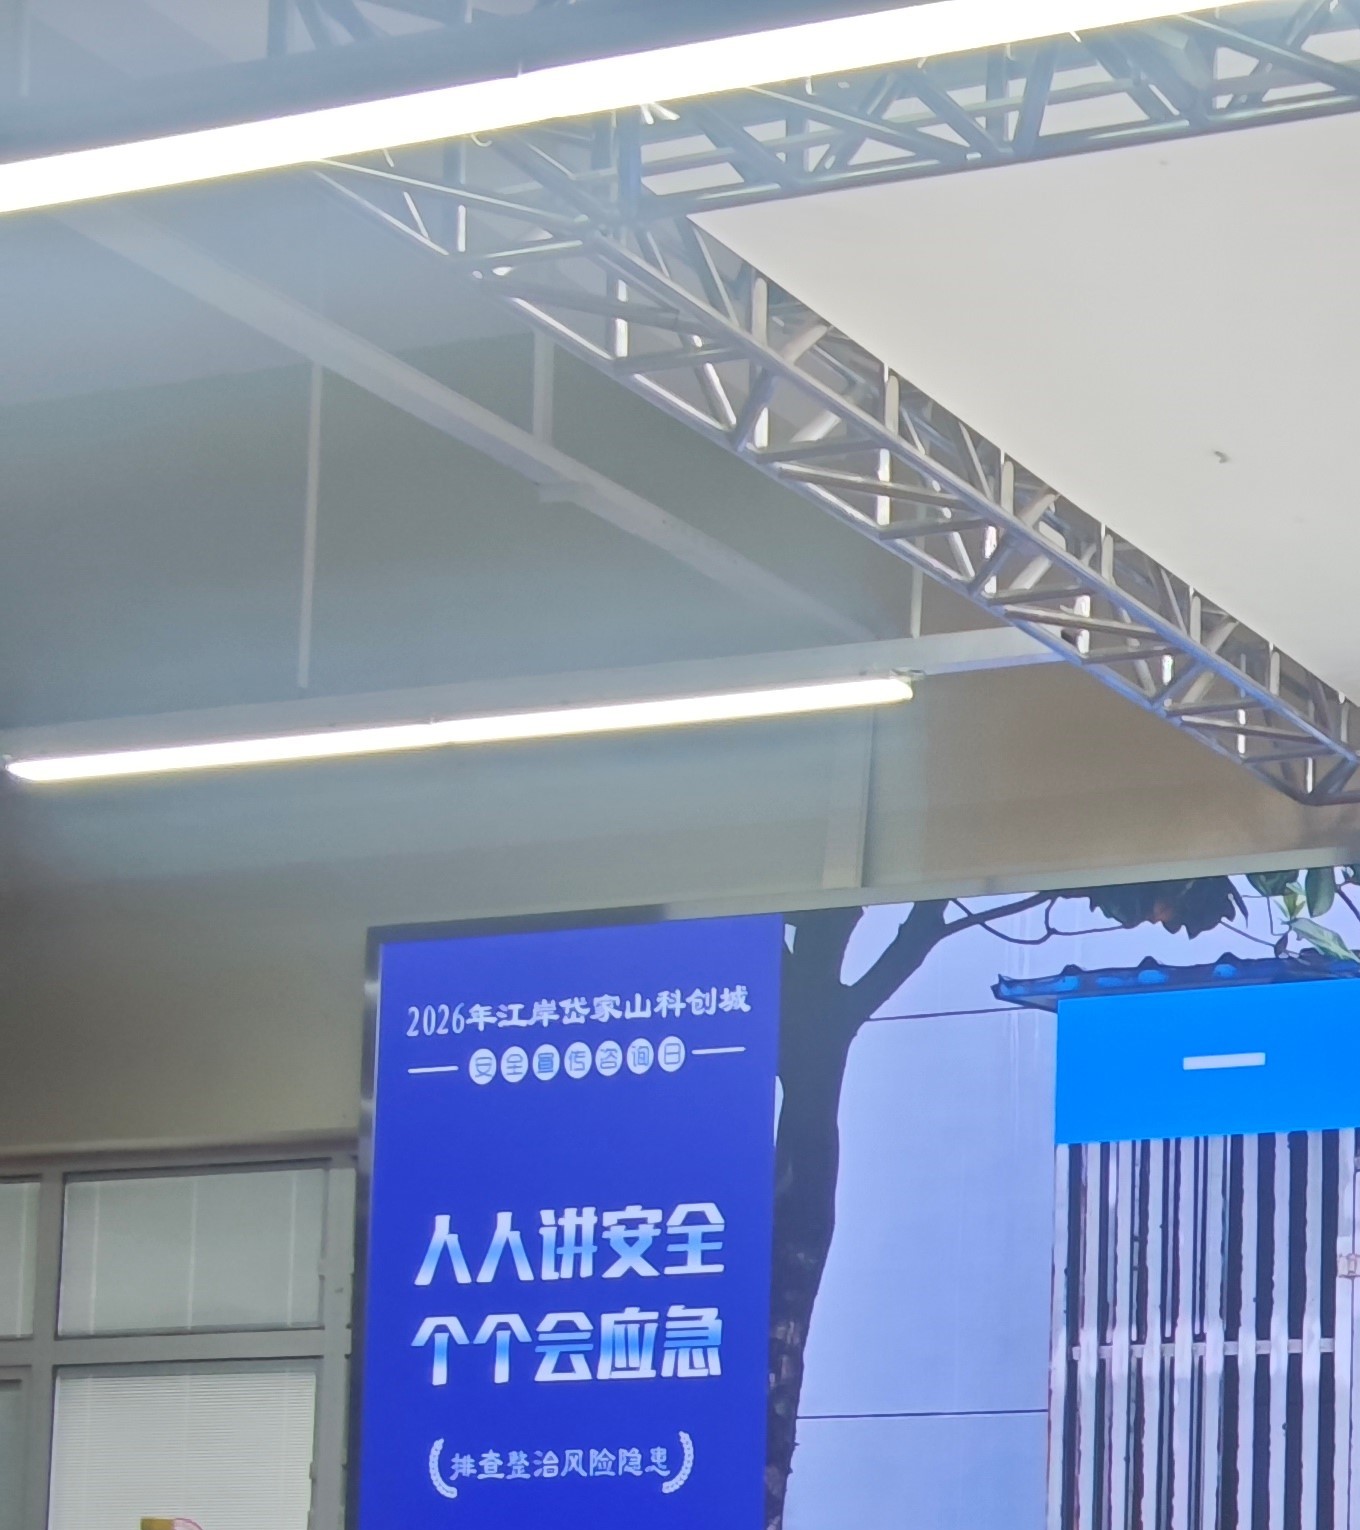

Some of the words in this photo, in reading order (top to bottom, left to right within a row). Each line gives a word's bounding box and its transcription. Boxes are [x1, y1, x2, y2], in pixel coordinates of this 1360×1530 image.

[406, 985, 751, 1037] 2026年江岸岱家山科创城
[414, 1202, 725, 1286] 人人讲安全
[411, 1305, 722, 1385] 个个会应急
[449, 1447, 670, 1481] 排查整治风险隐患
